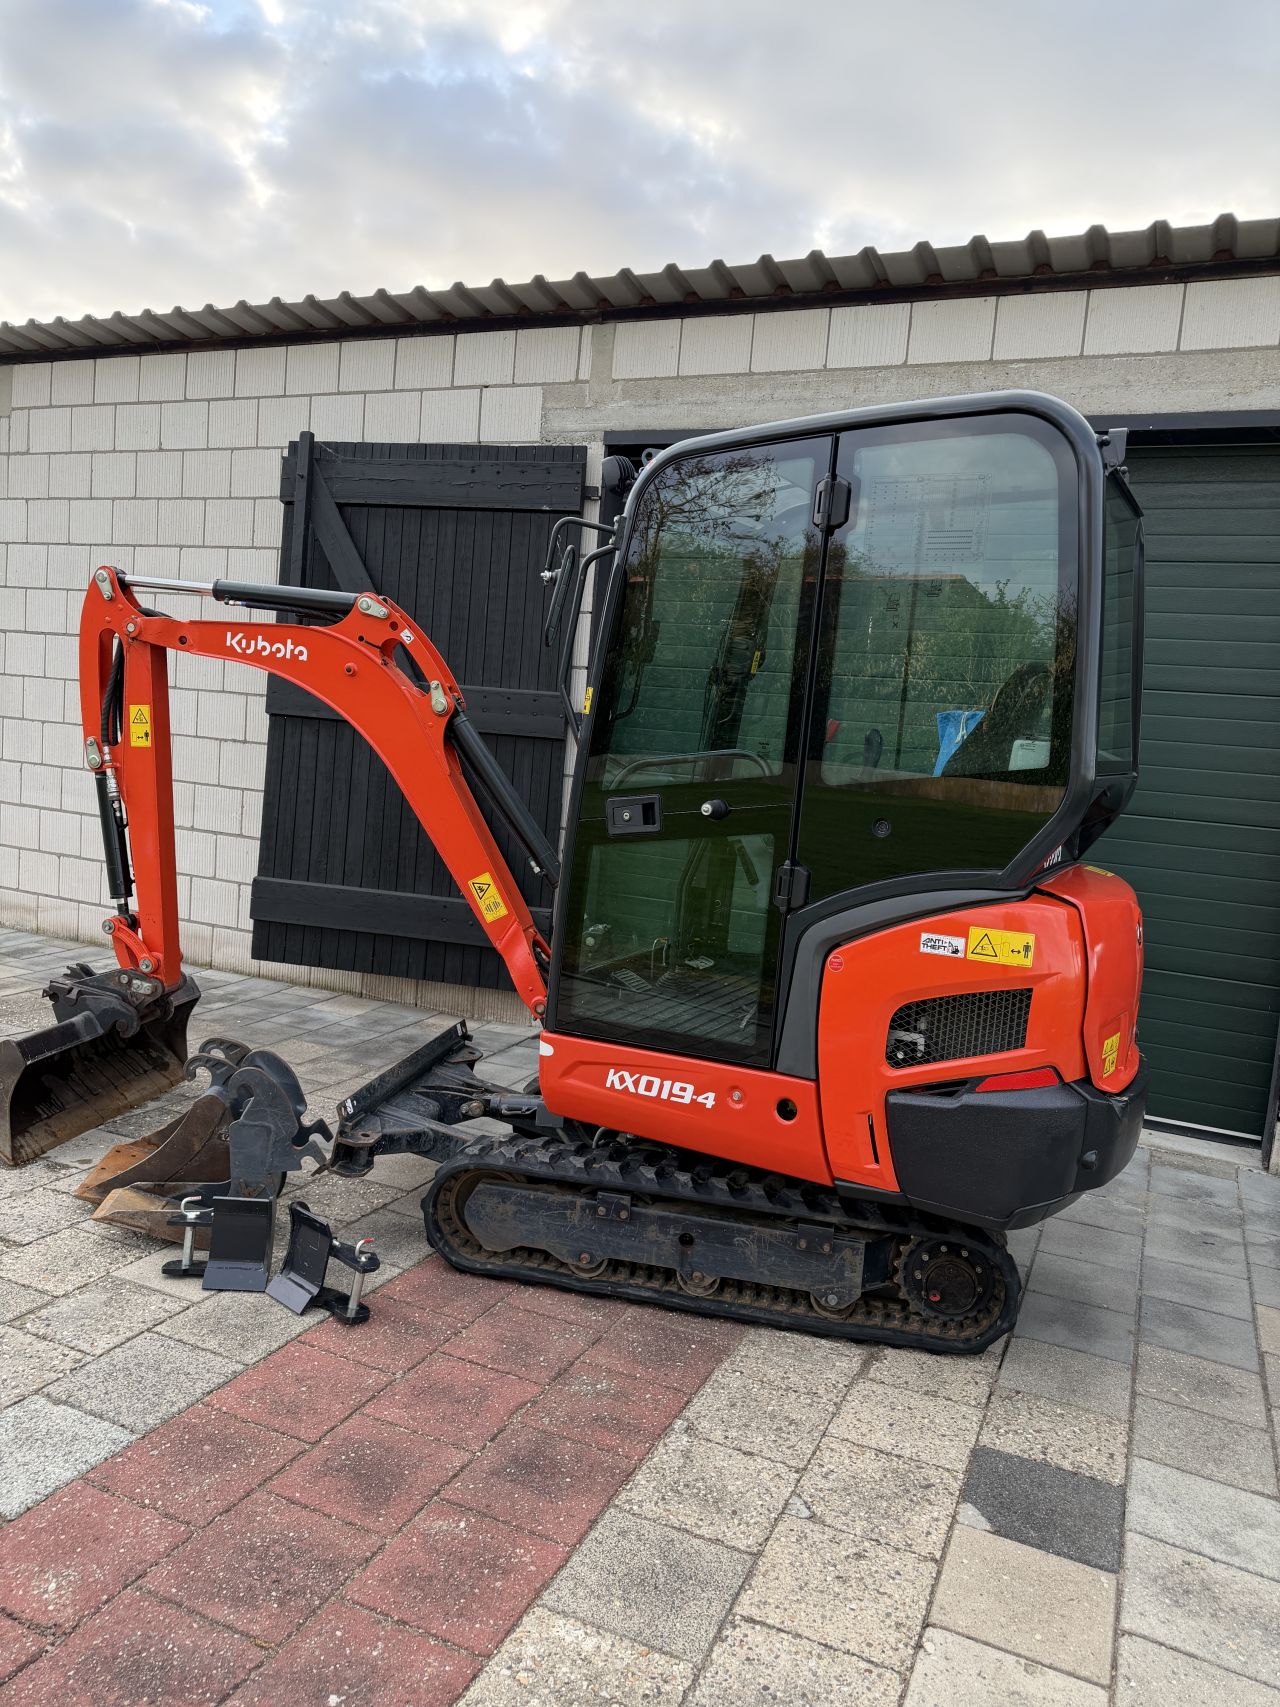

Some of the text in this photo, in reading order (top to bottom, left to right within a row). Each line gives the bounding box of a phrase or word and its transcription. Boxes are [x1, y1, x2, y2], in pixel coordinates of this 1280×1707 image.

[226, 631, 308, 661] Kubota
[922, 943, 948, 951] THEFT
[606, 1068, 716, 1109] KX019-4
